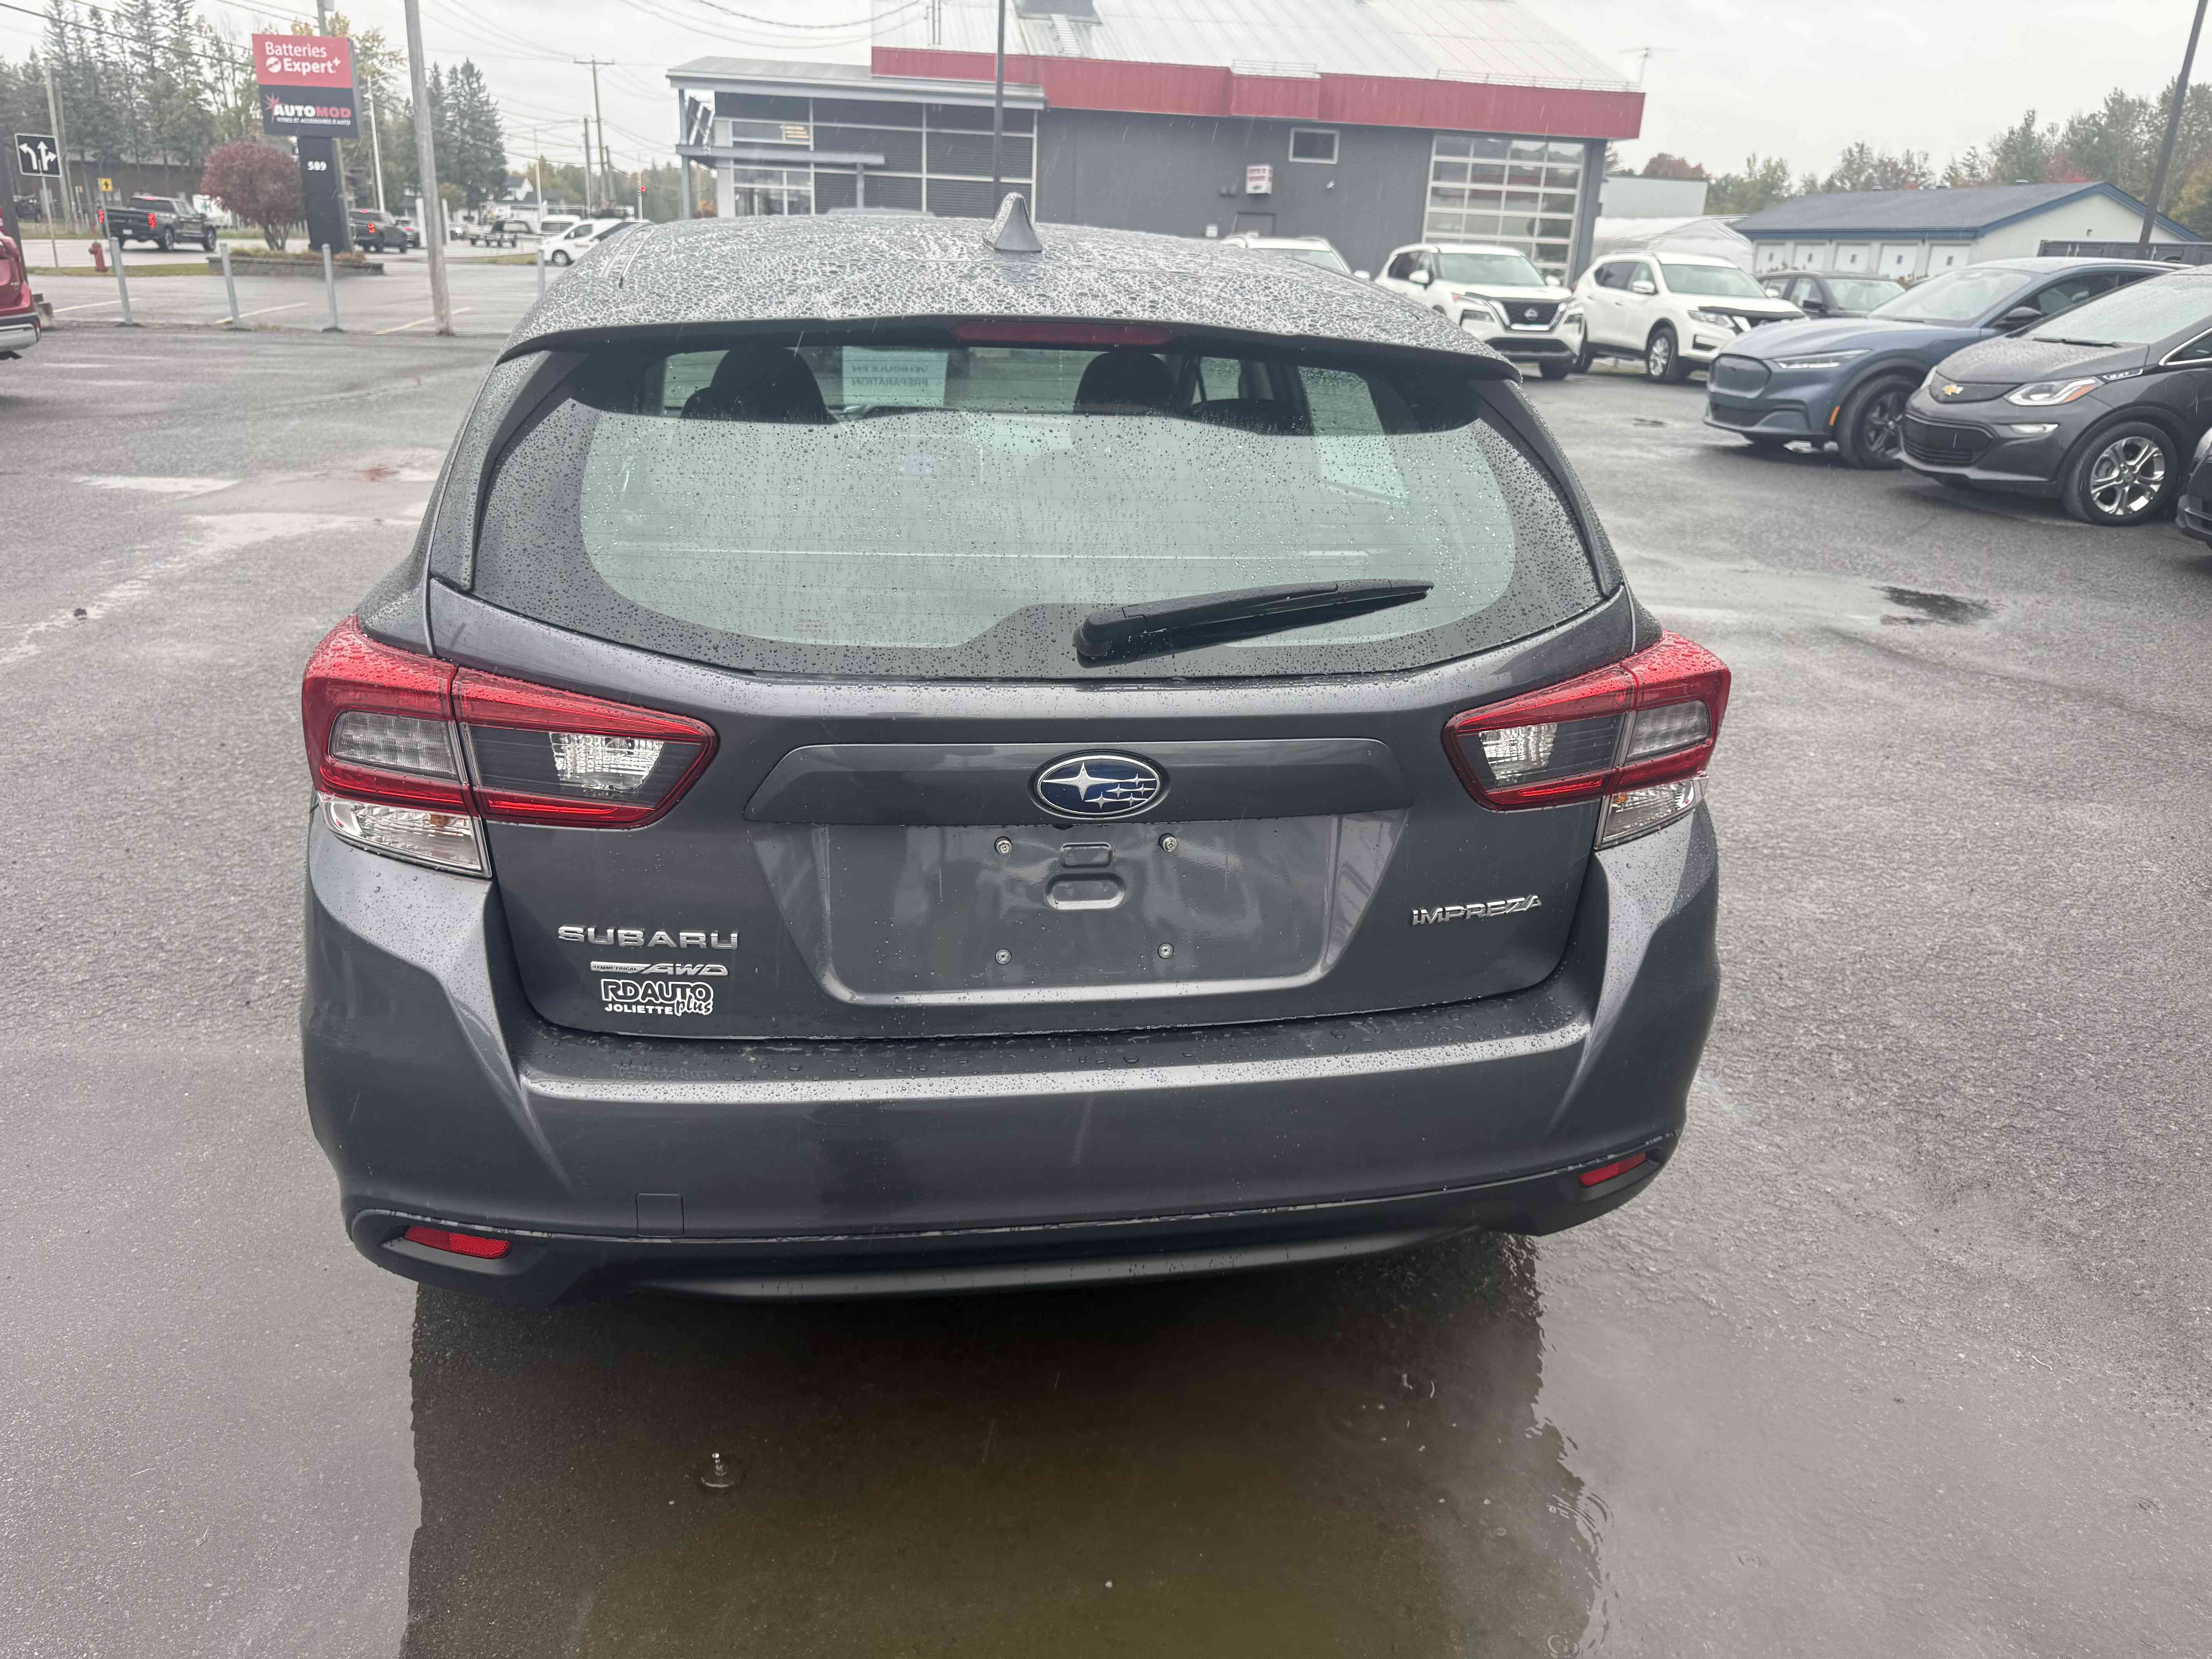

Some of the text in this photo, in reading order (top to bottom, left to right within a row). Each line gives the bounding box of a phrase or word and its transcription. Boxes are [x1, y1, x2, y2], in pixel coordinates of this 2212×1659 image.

[264, 41, 327, 58] Batteries
[274, 105, 352, 118] AUTOMOD
[307, 161, 327, 171] 589
[1412, 894, 1542, 926] IMPREZA
[558, 925, 739, 950] SUBARU
[641, 963, 728, 976] AWD
[605, 993, 714, 1016] JOLIETTE plus
